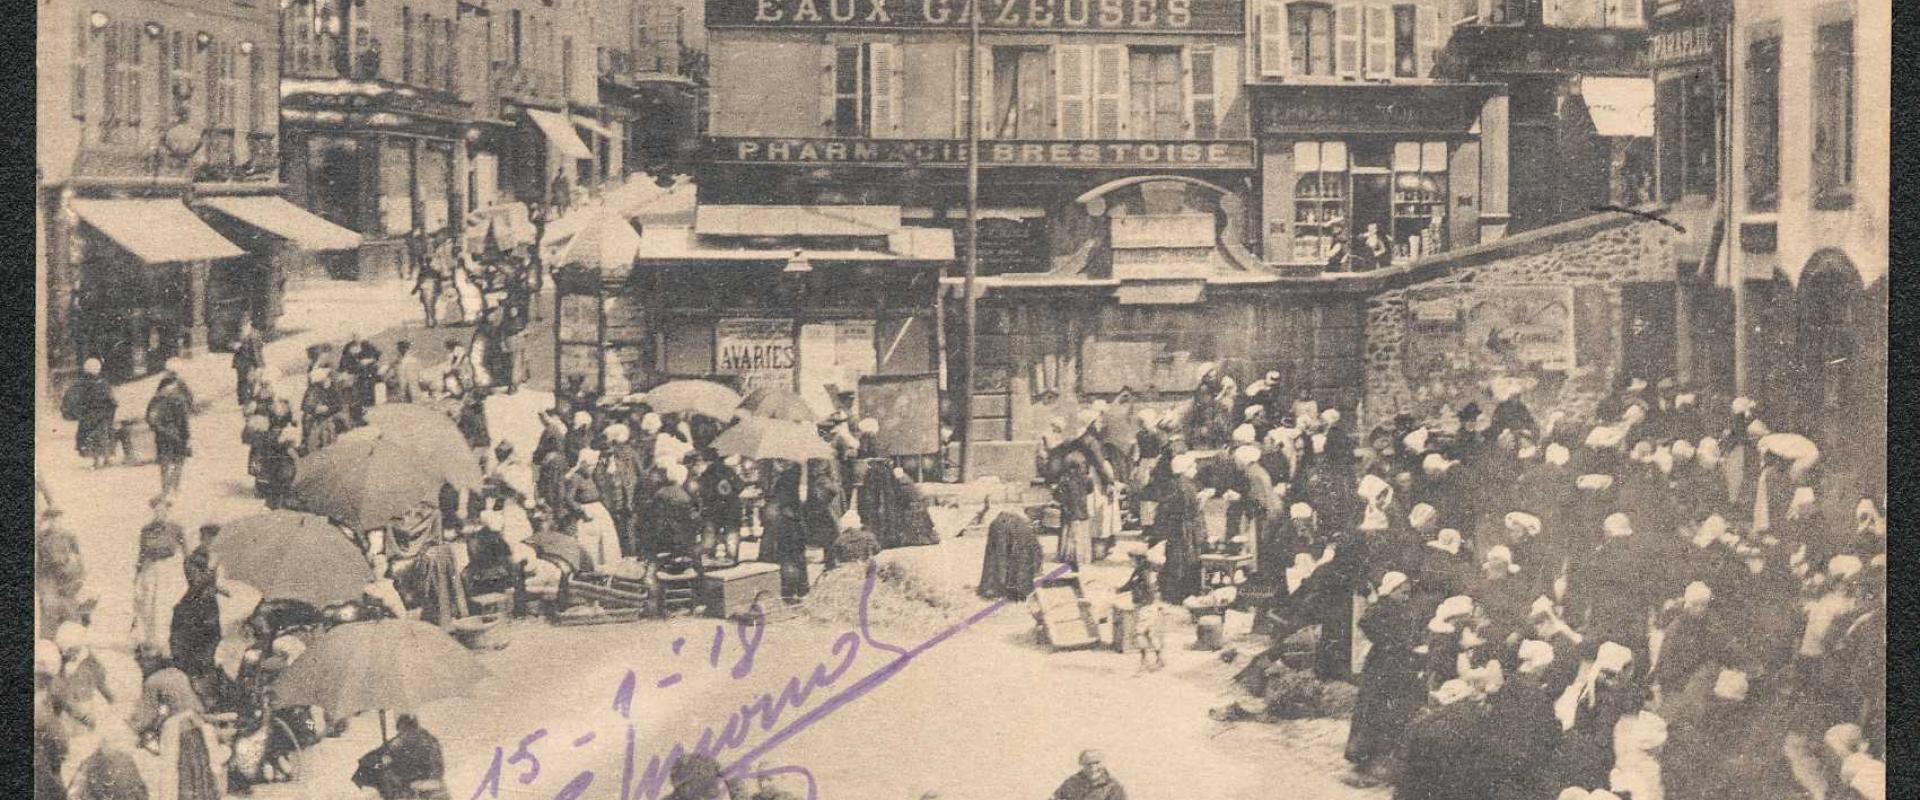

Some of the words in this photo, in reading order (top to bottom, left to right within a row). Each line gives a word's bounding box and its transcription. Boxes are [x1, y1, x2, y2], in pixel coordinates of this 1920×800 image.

[754, 0, 891, 22] EAUX
[922, 0, 1192, 27] GAZEUSES
[992, 143, 1229, 162] BRESTOISE
[721, 344, 796, 370] AVARIES
